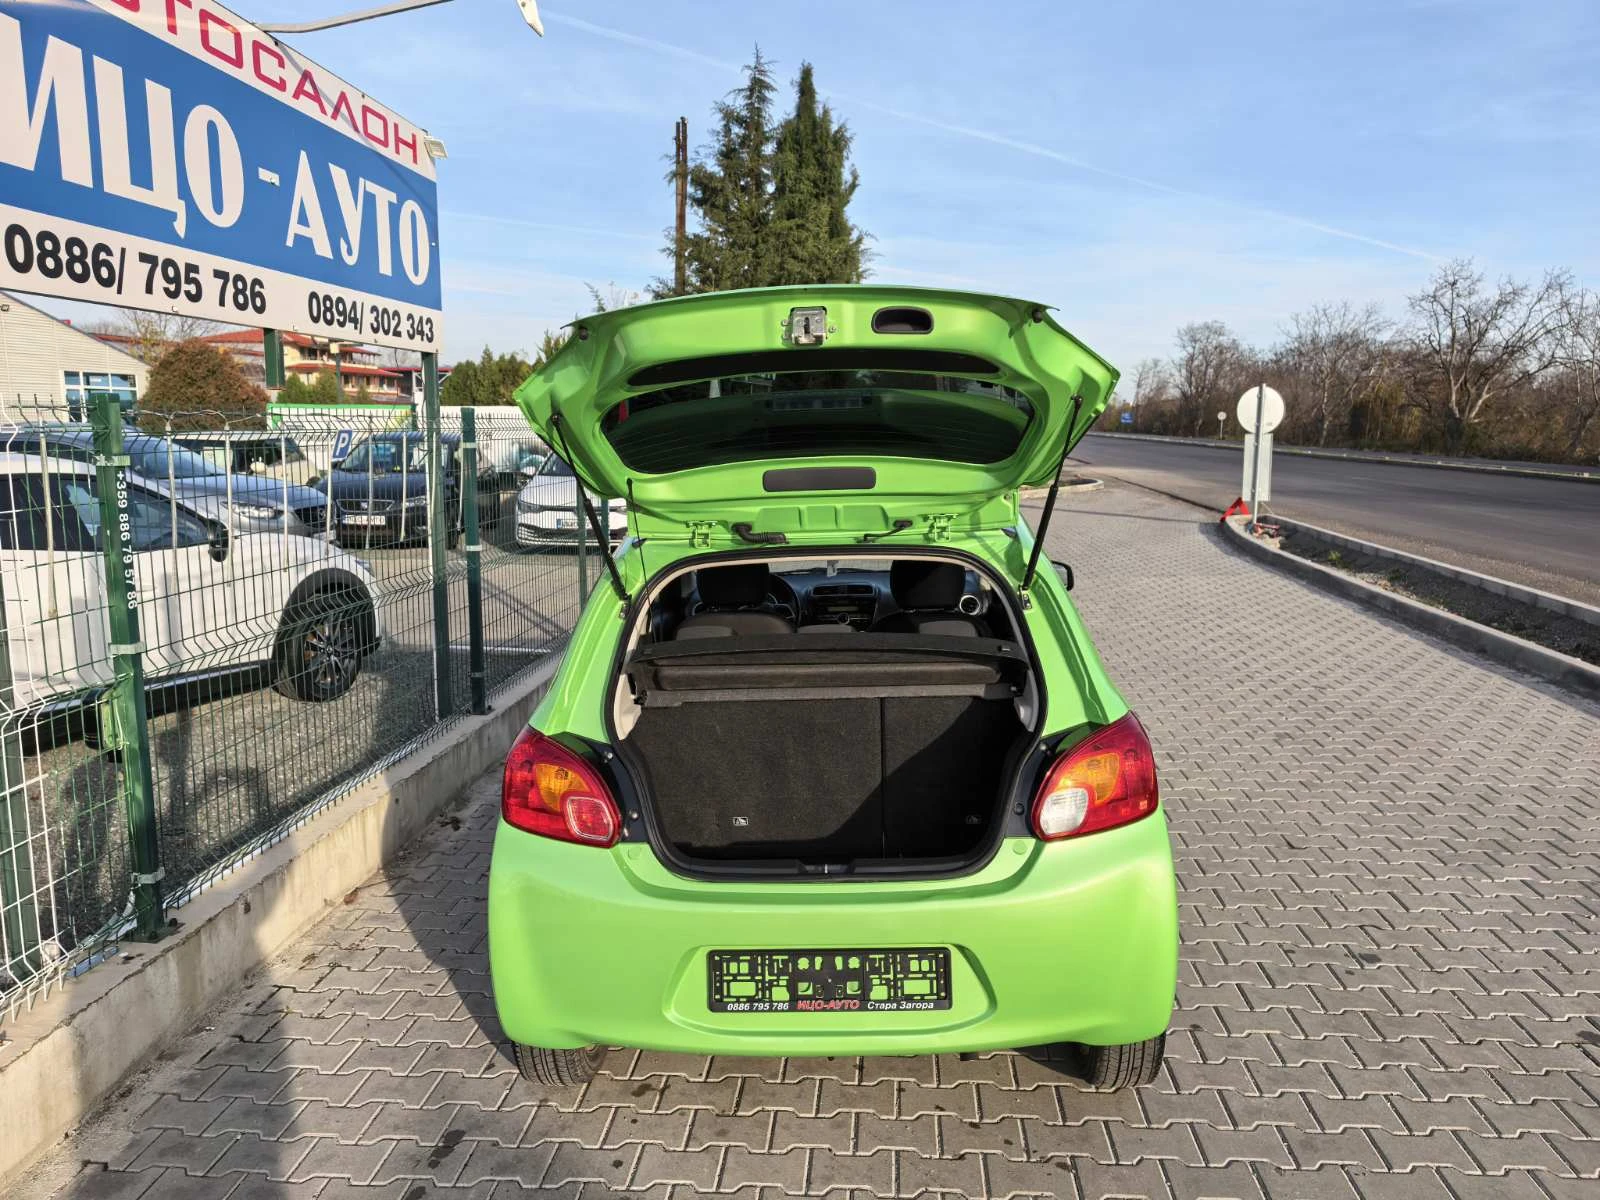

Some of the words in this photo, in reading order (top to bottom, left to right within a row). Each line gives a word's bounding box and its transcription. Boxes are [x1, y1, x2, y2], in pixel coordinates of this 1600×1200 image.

[110, 0, 419, 164] ТОСАЛОН
[138, 251, 203, 304] 795
[213, 268, 267, 315] 786
[370, 304, 402, 338] 302
[406, 312, 434, 343] 343
[335, 432, 349, 456] P
[116, 470, 128, 508] +359
[119, 513, 131, 541] 886
[127, 590, 138, 610] 86
[727, 1002, 750, 1011] 0886
[753, 1002, 770, 1011] 795
[772, 1002, 789, 1011] 786
[867, 1001, 897, 1011] Стара
[899, 1000, 934, 1010] Загора
